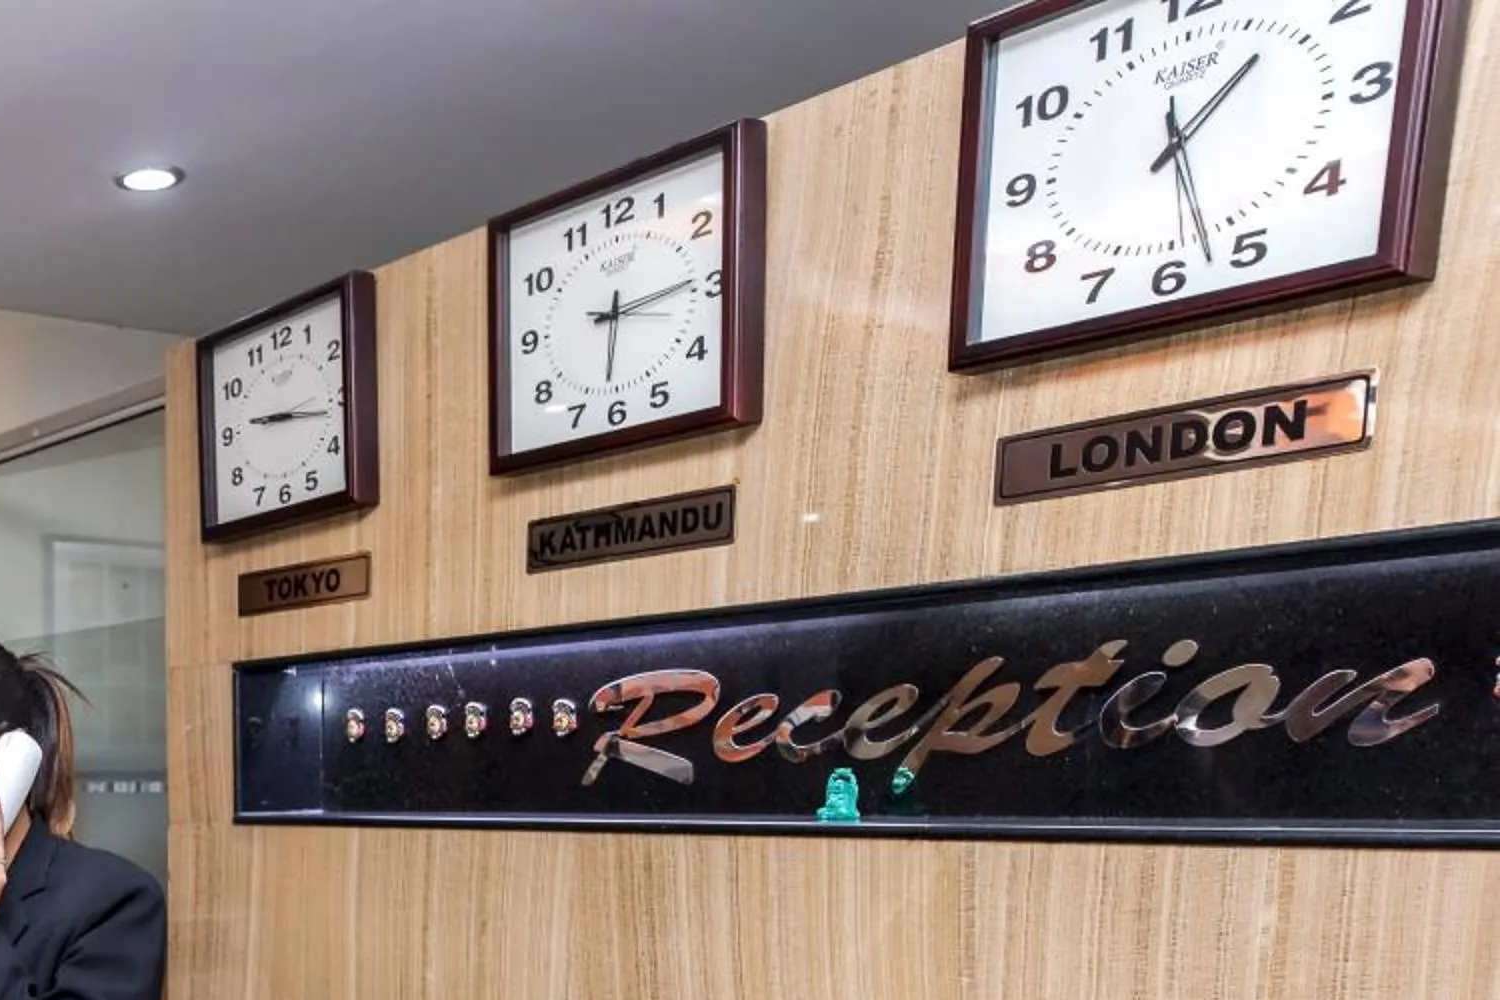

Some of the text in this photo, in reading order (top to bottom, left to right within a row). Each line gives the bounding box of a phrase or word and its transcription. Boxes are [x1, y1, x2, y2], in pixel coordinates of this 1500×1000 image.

[1089, 17, 1135, 62] 11
[1153, 51, 1219, 85] KAISER
[1349, 61, 1394, 104] 3
[1015, 84, 1069, 129] 10
[1005, 173, 1037, 208] 9
[1303, 159, 1347, 197] 4
[600, 196, 635, 229] 12
[653, 192, 665, 218] 1
[563, 222, 587, 251] 11
[691, 210, 712, 240] 2
[1023, 240, 1057, 274] 8
[1229, 228, 1268, 269] 5
[523, 267, 554, 297] 10
[705, 270, 723, 298] 3
[1081, 267, 1116, 305] 7
[1151, 261, 1188, 297] 6
[270, 326, 292, 351] 12
[303, 324, 311, 345] 1
[521, 330, 539, 355] 9
[685, 335, 708, 361] 4
[247, 344, 263, 367] 11
[327, 340, 341, 362] 2
[222, 377, 242, 401] 10
[534, 380, 553, 404] 8
[649, 381, 669, 409] 5
[567, 403, 587, 430] 7
[607, 401, 627, 426] 6
[222, 427, 233, 447] 9
[327, 435, 340, 456] 4
[1049, 400, 1308, 480] LONDON
[231, 467, 243, 487] 8
[304, 470, 318, 492] 5
[252, 486, 266, 507] 7
[278, 484, 291, 505] 6
[538, 502, 724, 561] KATHMANDU
[263, 568, 341, 601] TOKYO
[581, 638, 1440, 786] Reception
